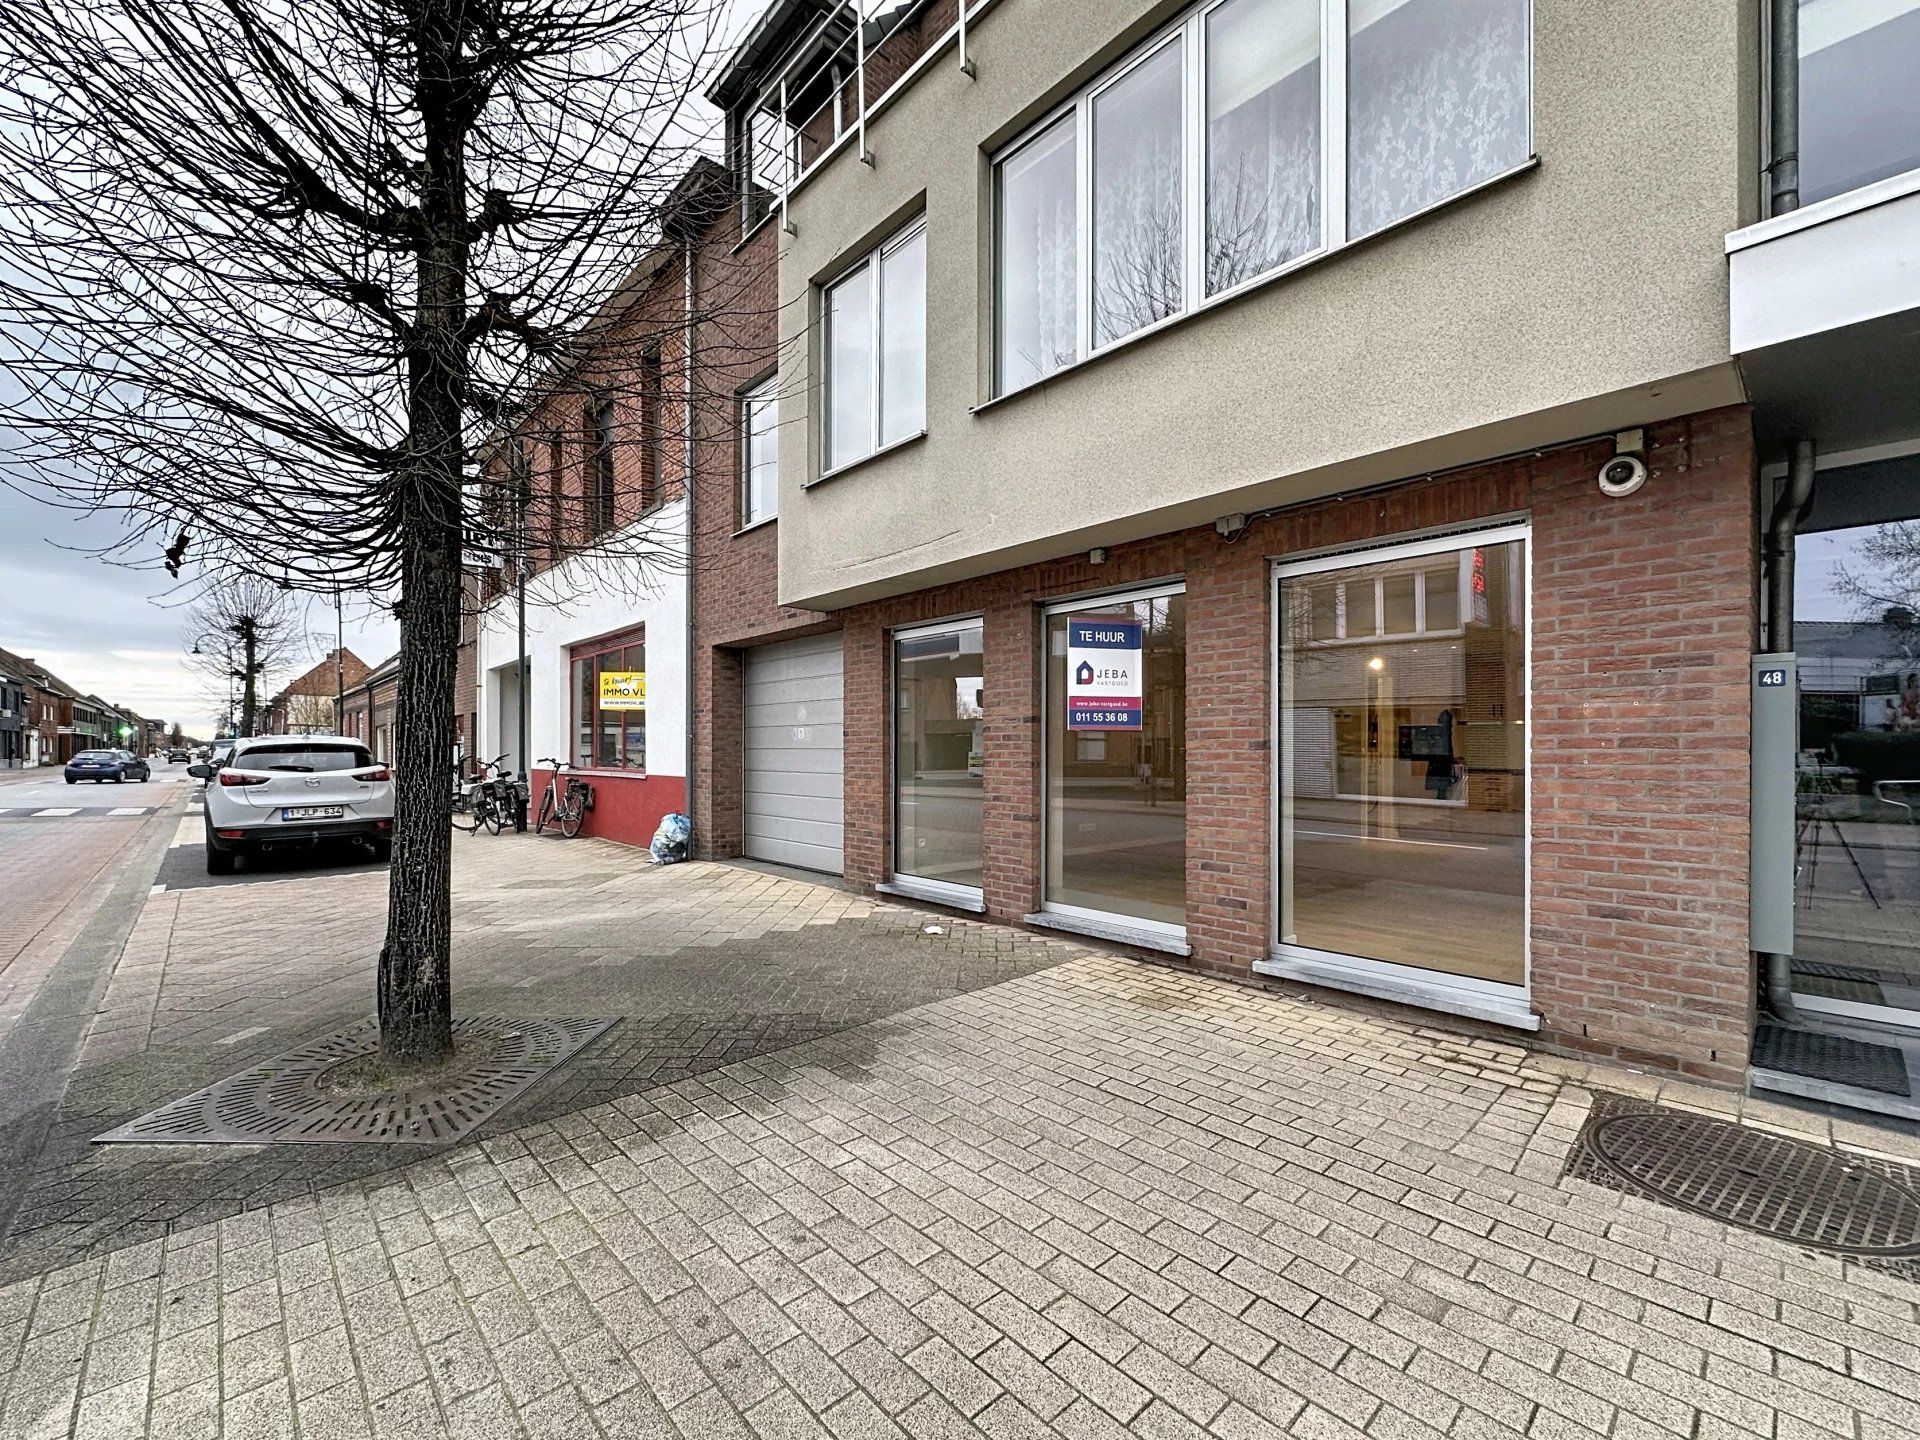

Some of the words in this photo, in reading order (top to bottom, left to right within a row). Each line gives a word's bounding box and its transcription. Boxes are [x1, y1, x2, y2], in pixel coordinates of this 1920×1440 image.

[1079, 630, 1092, 641] TE
[1095, 631, 1125, 643] HUUR
[1096, 669, 1128, 679] JEBA
[1762, 671, 1782, 685] 48
[603, 688, 630, 696] IMMO
[632, 688, 645, 697] VL
[1075, 712, 1090, 722] 011
[1092, 712, 1104, 722] 55
[1105, 712, 1116, 722] 36
[1117, 712, 1128, 722] 08
